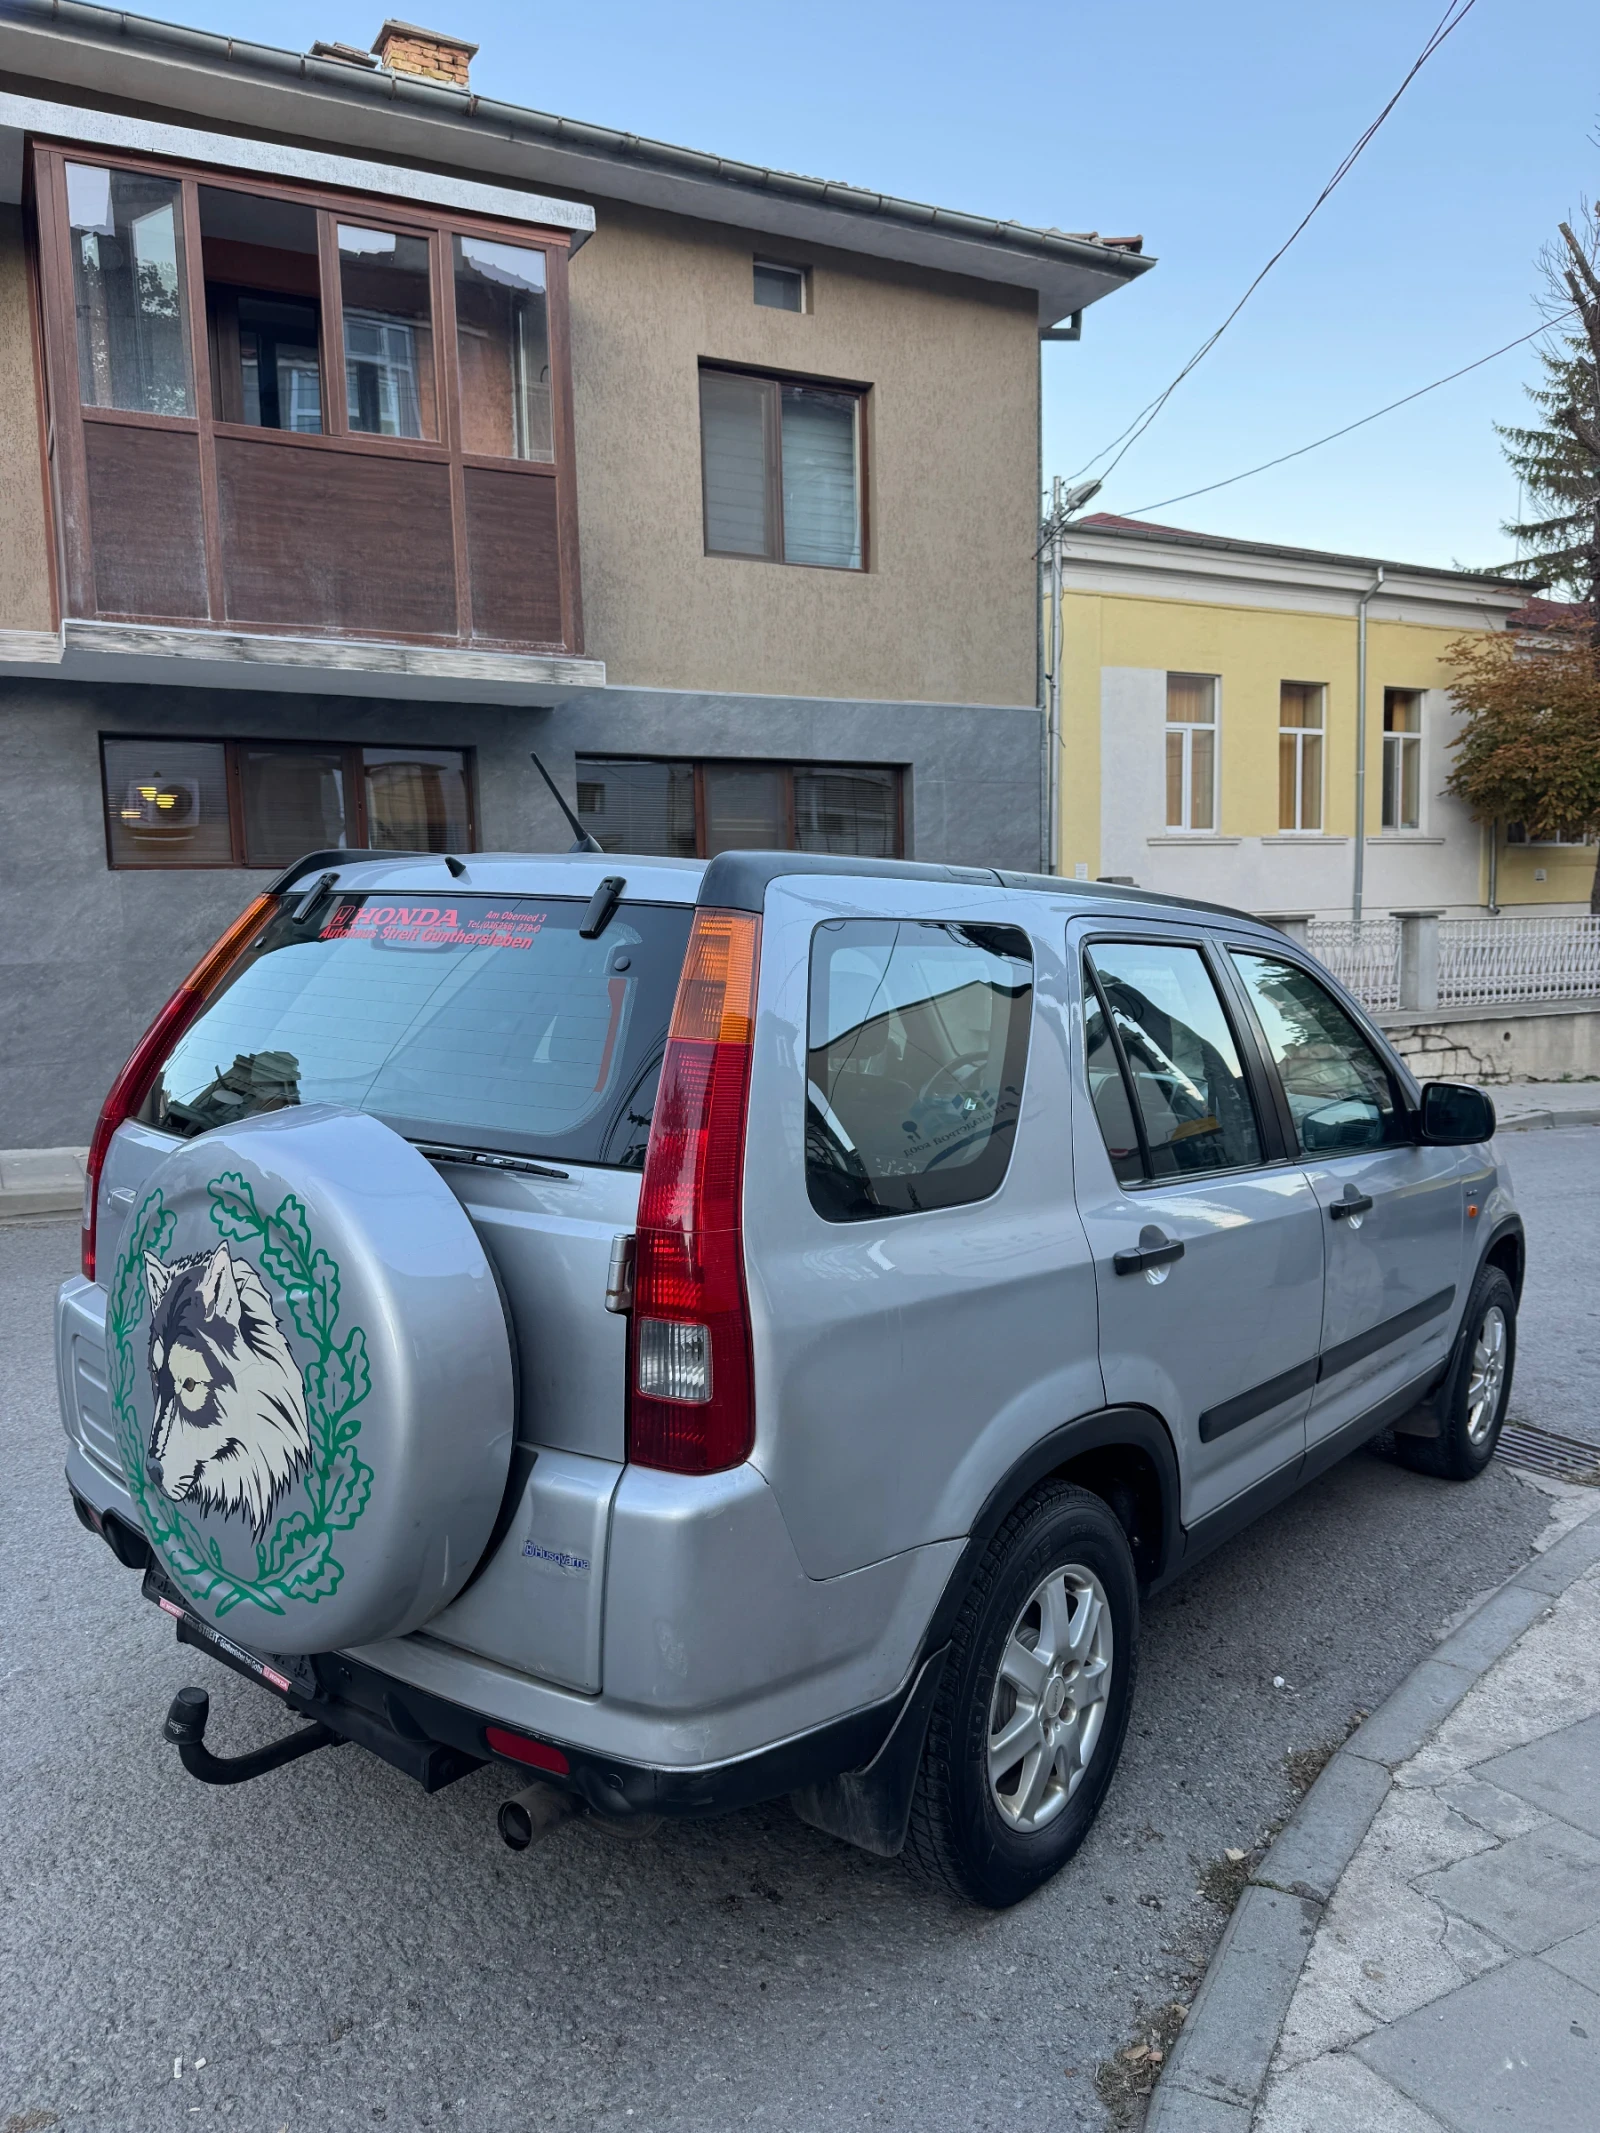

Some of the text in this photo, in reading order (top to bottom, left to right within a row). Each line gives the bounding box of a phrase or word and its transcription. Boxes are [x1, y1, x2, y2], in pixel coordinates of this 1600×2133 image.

[349, 907, 459, 928] HONDA
[485, 910, 548, 923] Am Oberried 3
[318, 925, 533, 950] Autohaus Streit Günthersleben
[534, 1545, 591, 1570] Husqvarna
[198, 1622, 219, 1643] STREIT
